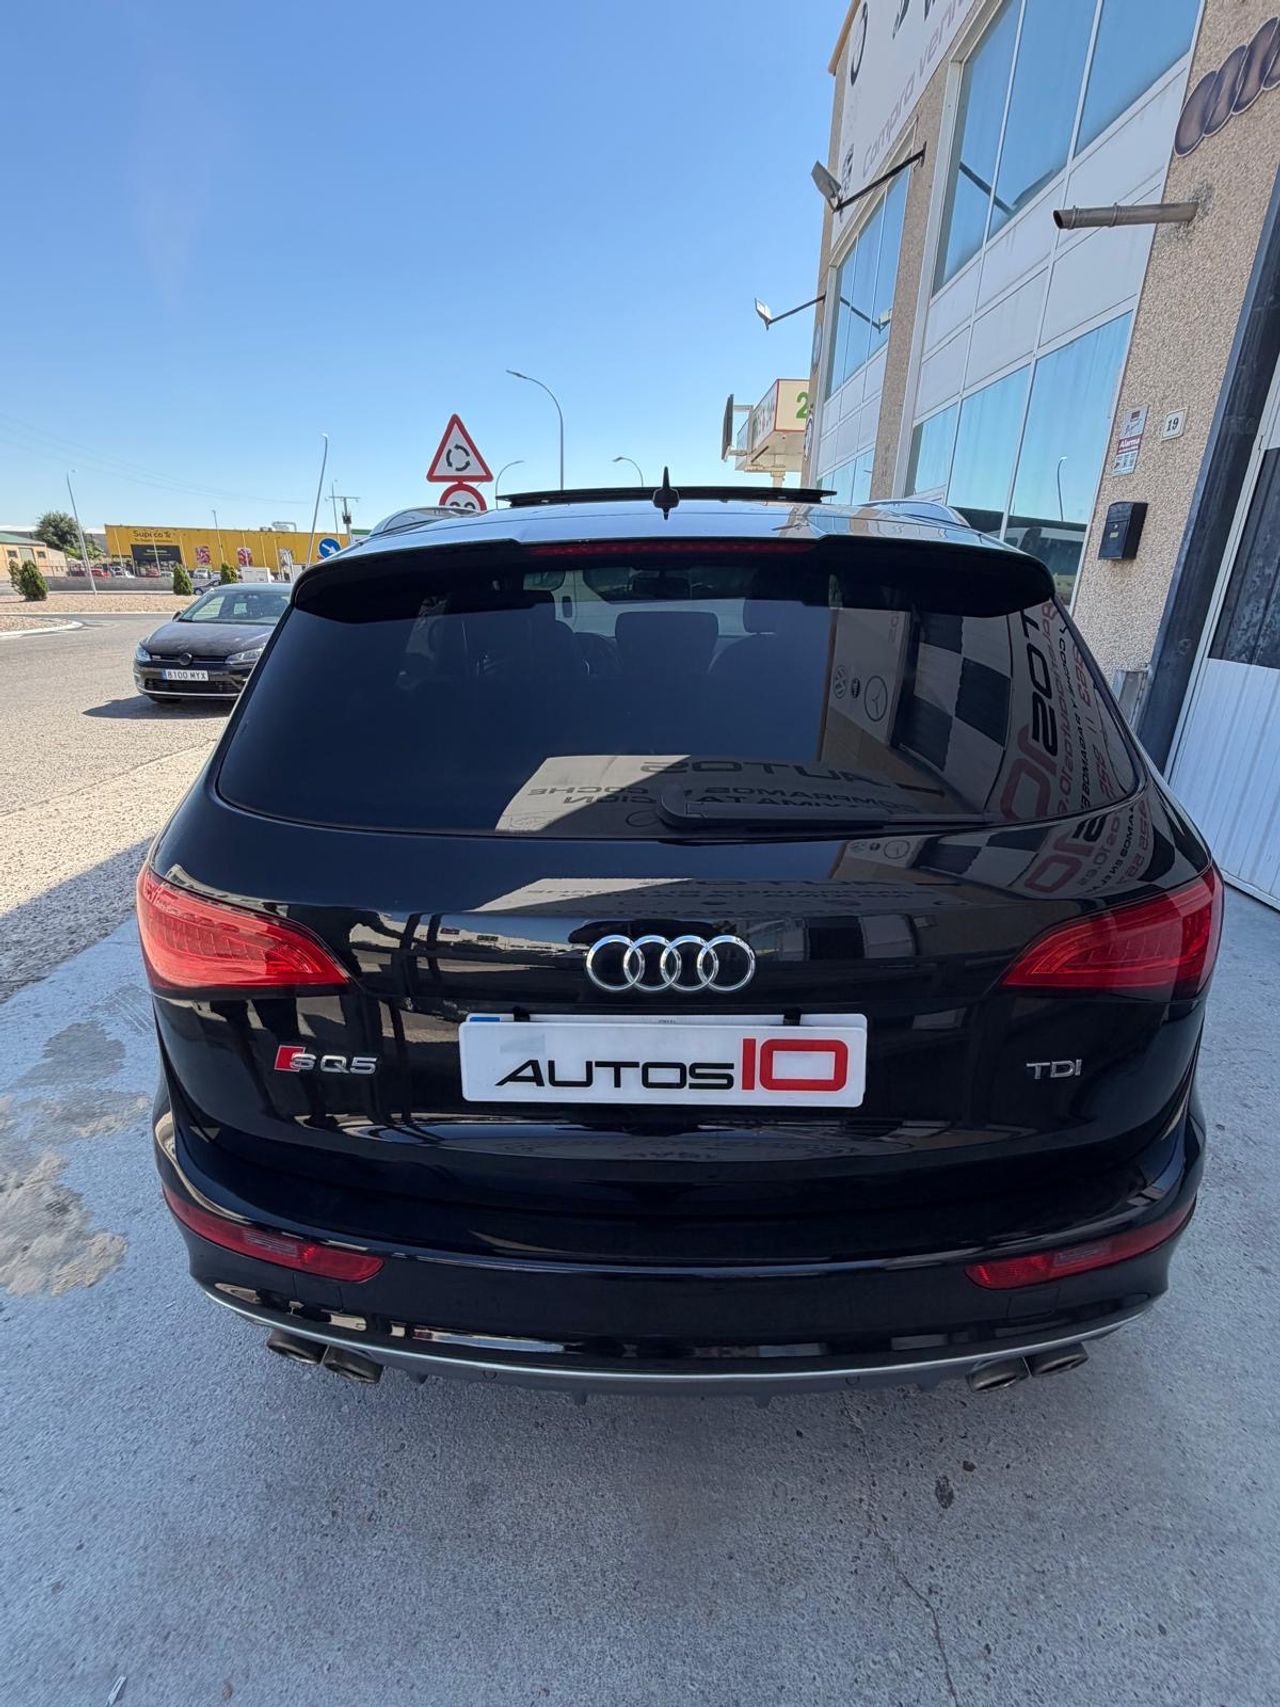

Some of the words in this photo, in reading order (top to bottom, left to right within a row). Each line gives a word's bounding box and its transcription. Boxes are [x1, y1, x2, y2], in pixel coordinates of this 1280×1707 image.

[1167, 417, 1179, 432] 19
[168, 671, 187, 680] 8100
[189, 672, 207, 680] MYX
[289, 1052, 378, 1075] SQ5
[494, 1037, 849, 1092] AUTOS10
[1025, 1059, 1082, 1080] TDI
